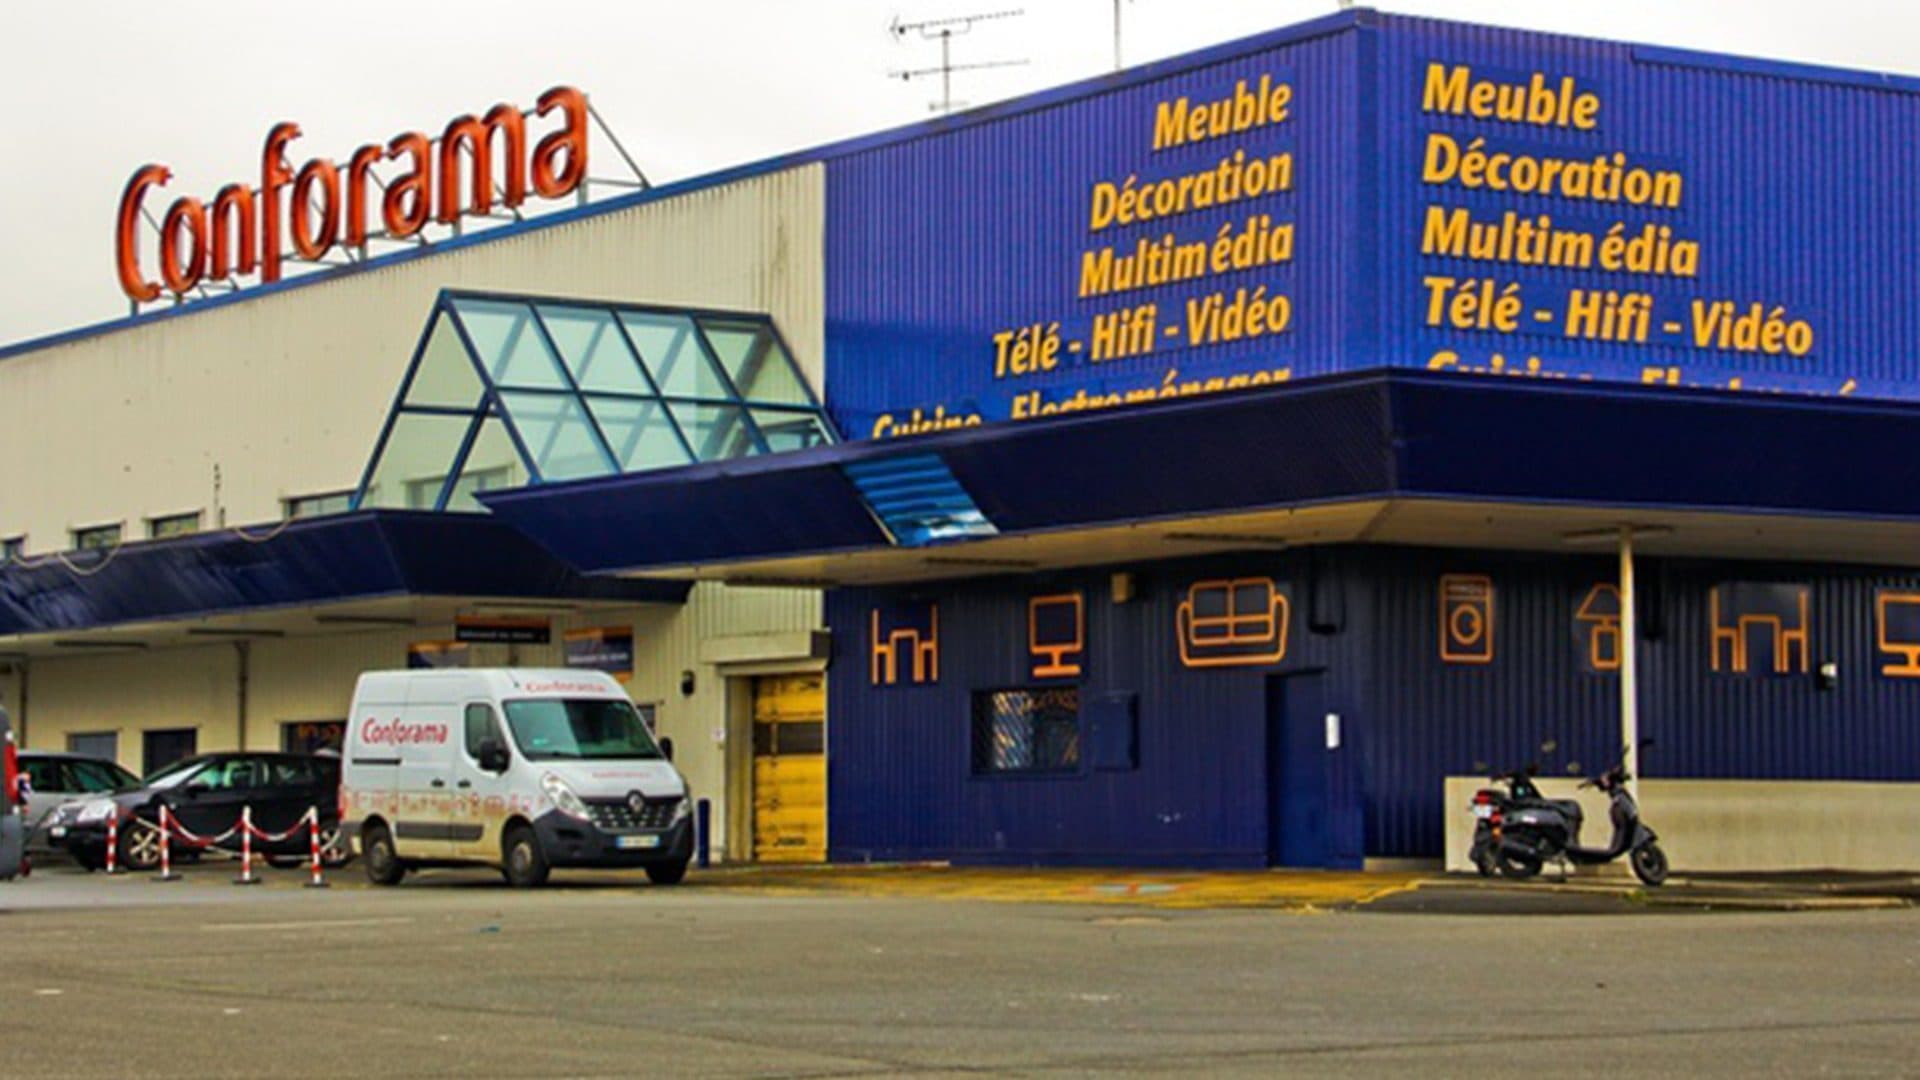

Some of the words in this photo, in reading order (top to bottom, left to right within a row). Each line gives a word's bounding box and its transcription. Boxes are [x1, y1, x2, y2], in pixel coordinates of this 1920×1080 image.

[1153, 75, 1292, 150] Meuble
[1422, 63, 1600, 129] Meuble
[116, 86, 589, 304] Conforama
[1090, 150, 1293, 231] Décoration
[1422, 133, 1682, 207] Décoration
[1079, 215, 1294, 298] Multimédia
[1421, 206, 1699, 276] Multimédia
[994, 323, 1060, 377] Télé
[1090, 304, 1157, 361] Hifi
[1187, 285, 1291, 345] Vidéo
[1423, 277, 1521, 332] Télé
[1565, 289, 1652, 342] Hifi
[1692, 300, 1814, 355] Vidéo
[361, 716, 449, 745] Conforama
